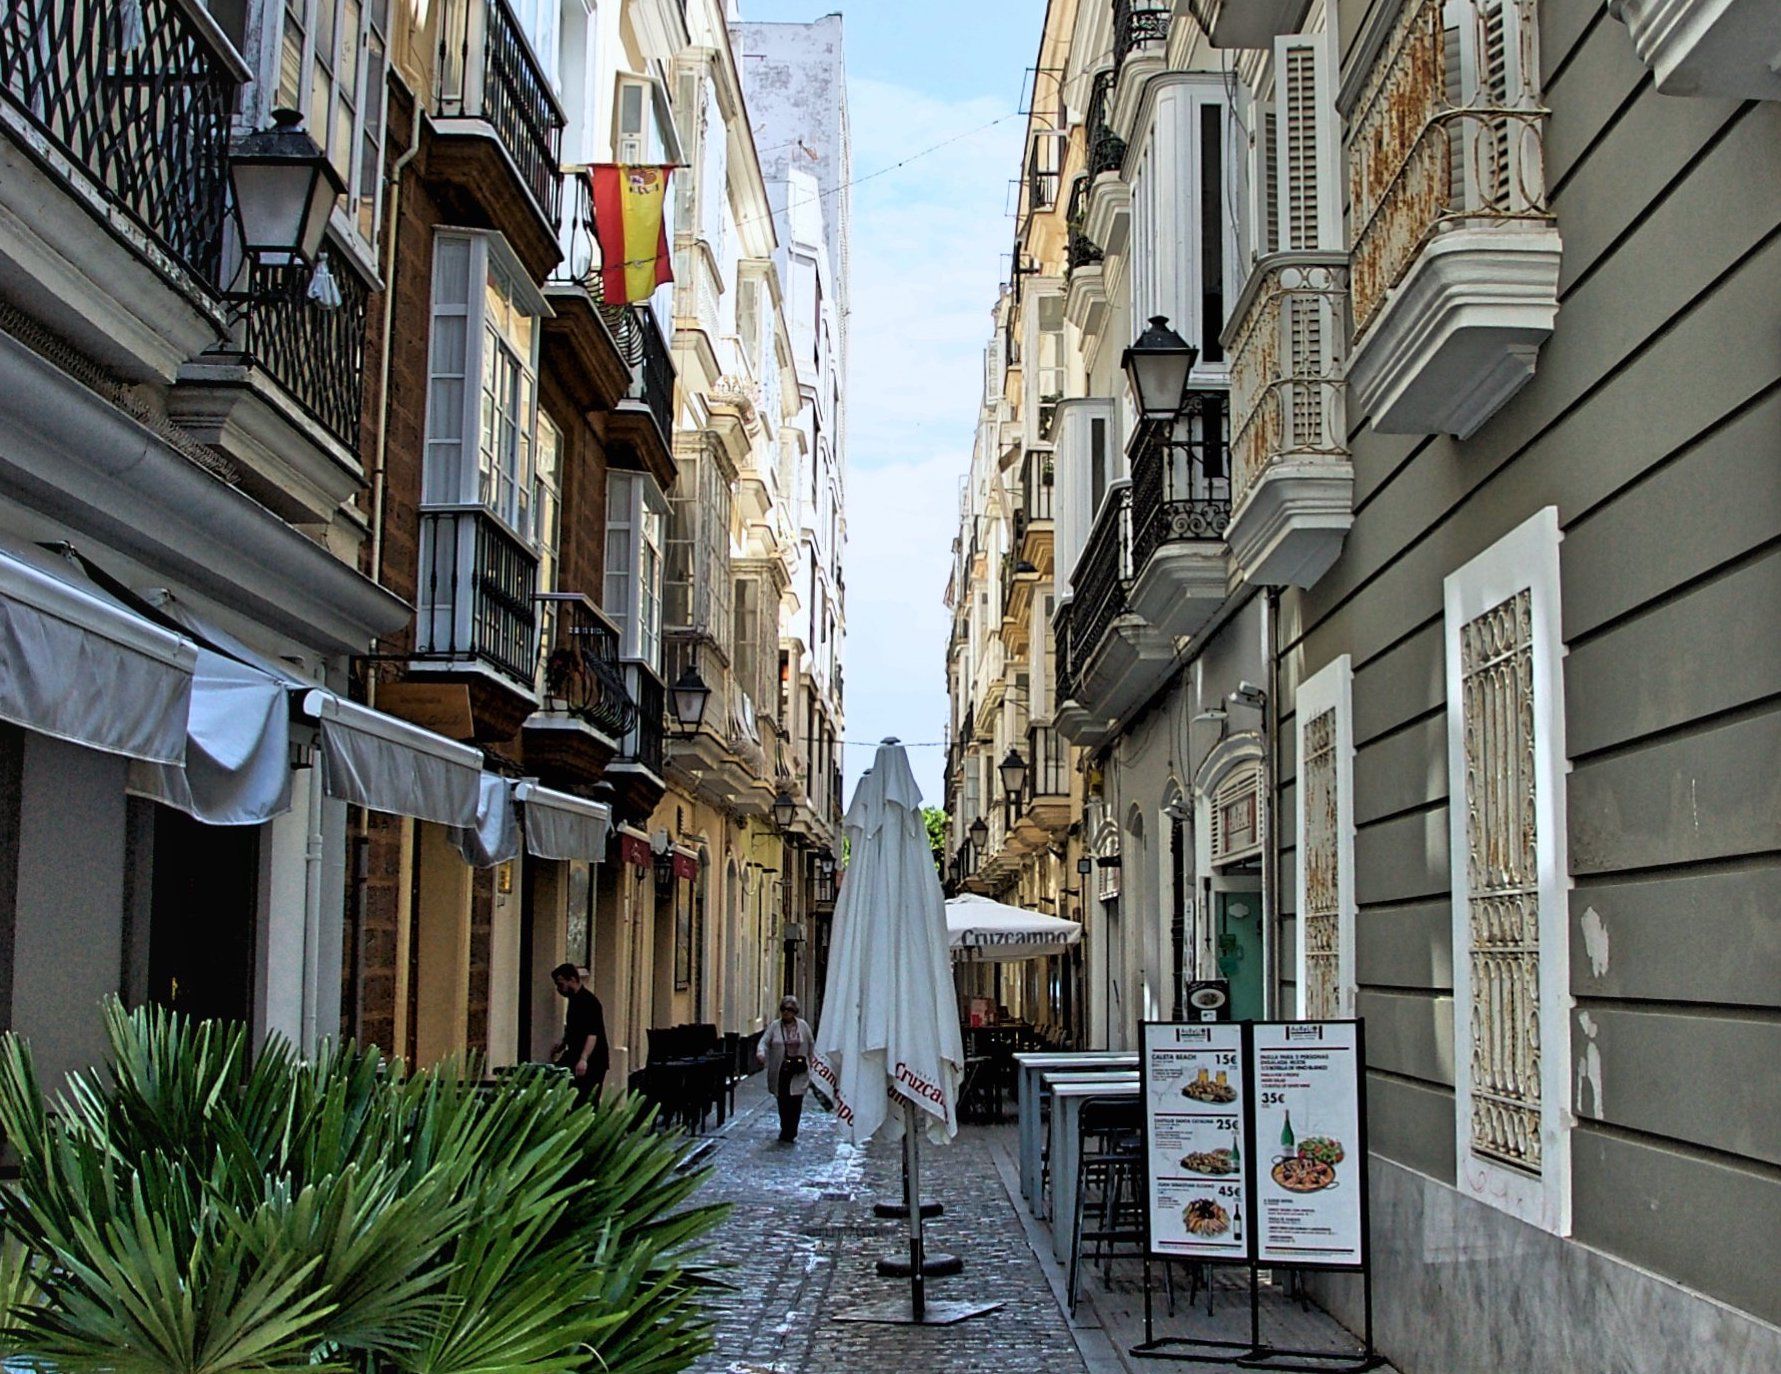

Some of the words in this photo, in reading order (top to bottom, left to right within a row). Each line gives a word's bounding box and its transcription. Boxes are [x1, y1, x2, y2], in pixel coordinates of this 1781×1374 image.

[961, 928, 1068, 946] Cruzcampo
[1215, 1054, 1237, 1065] 15€
[1261, 1092, 1285, 1104] 35€
[1216, 1118, 1239, 1130] 25€
[1218, 1185, 1241, 1197] 45€
